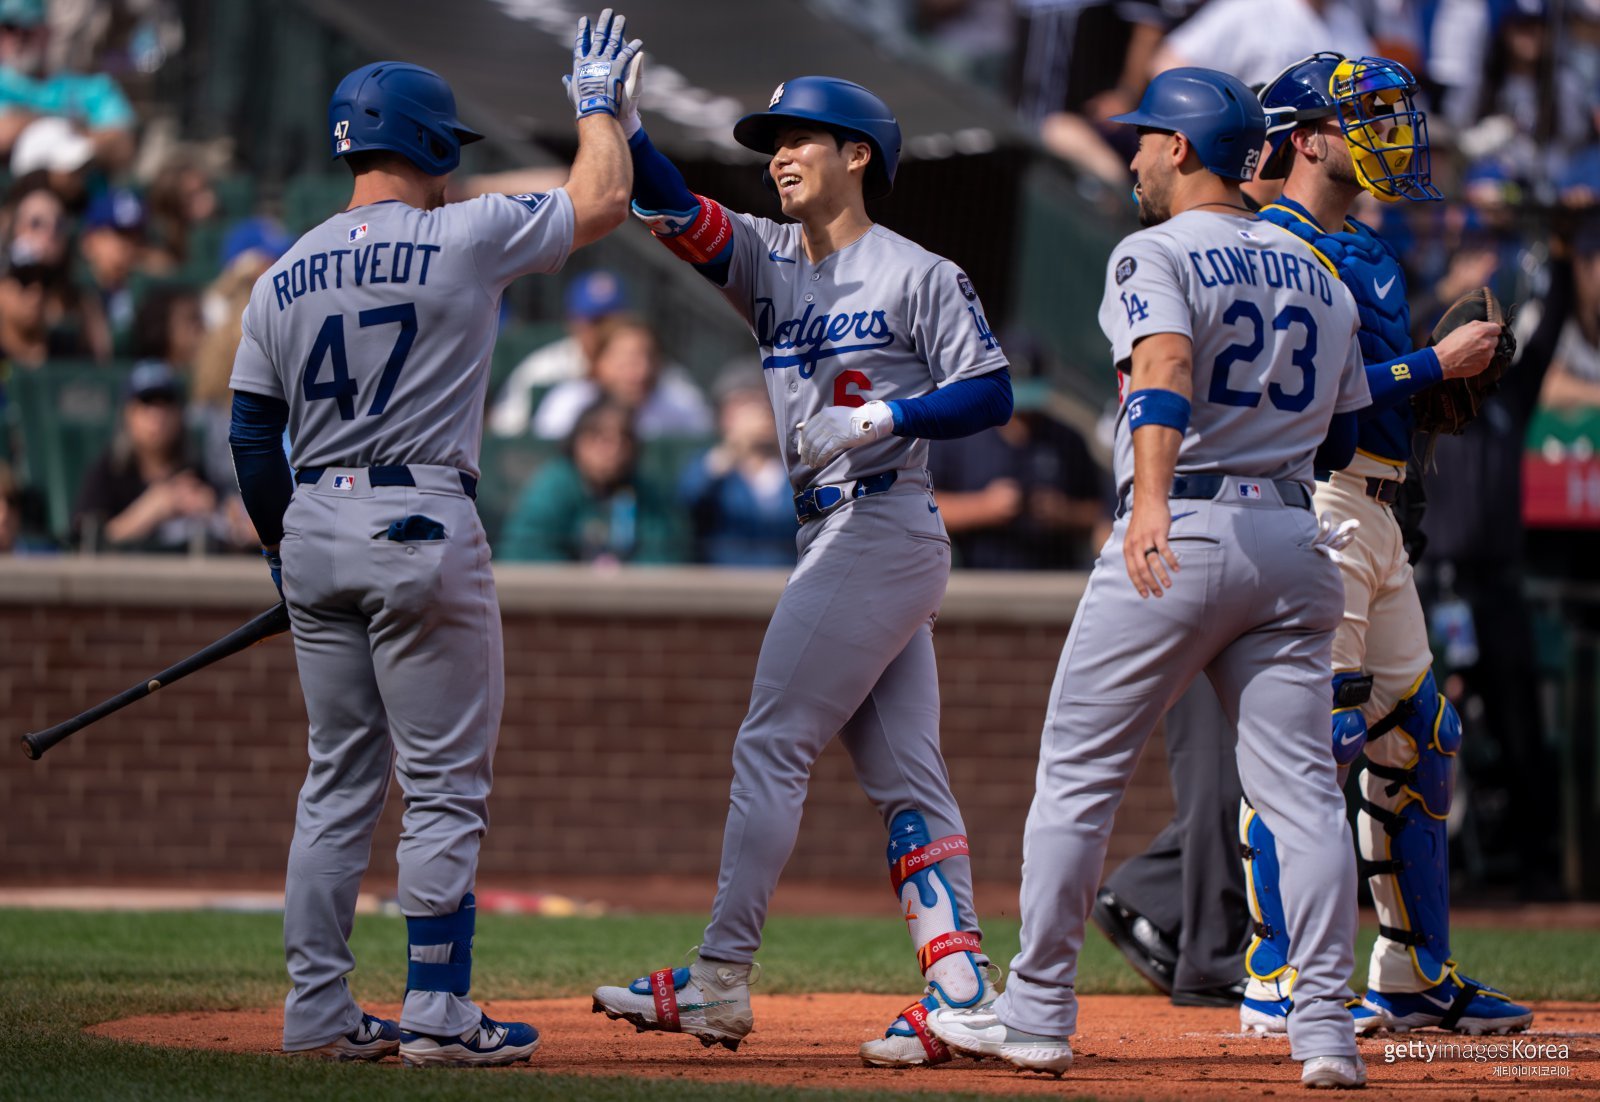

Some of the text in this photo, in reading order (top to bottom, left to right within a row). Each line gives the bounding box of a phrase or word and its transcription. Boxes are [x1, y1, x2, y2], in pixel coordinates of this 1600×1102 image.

[333, 120, 350, 139] 47
[1244, 148, 1260, 168] 23
[273, 242, 441, 312] RORTVEDT
[1189, 246, 1333, 308] CONFORTO
[755, 297, 895, 380] Dodgers
[1120, 291, 1149, 330] LA
[303, 302, 419, 421] 47
[1208, 299, 1318, 413] 23
[1391, 363, 1412, 381] 18
